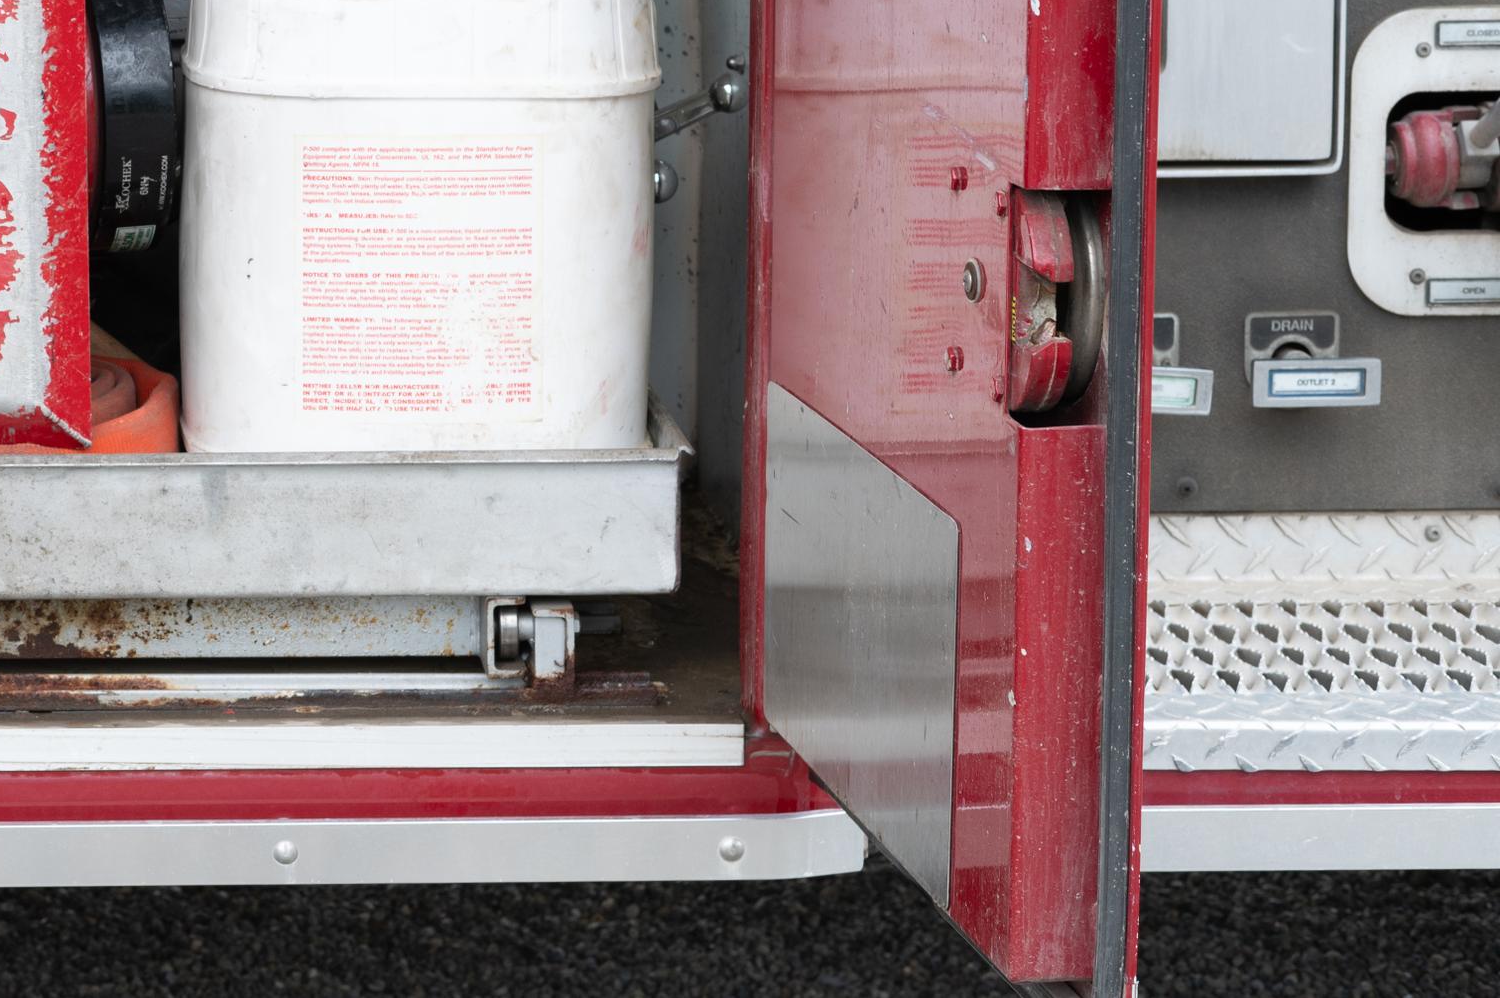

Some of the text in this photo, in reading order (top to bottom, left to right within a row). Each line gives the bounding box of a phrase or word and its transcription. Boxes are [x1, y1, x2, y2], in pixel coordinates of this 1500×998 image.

[1466, 29, 1500, 37] CLOSED
[115, 159, 132, 213] KOCHEK
[1271, 319, 1314, 332] DRAIN
[1296, 378, 1336, 386] OUTLET 2
